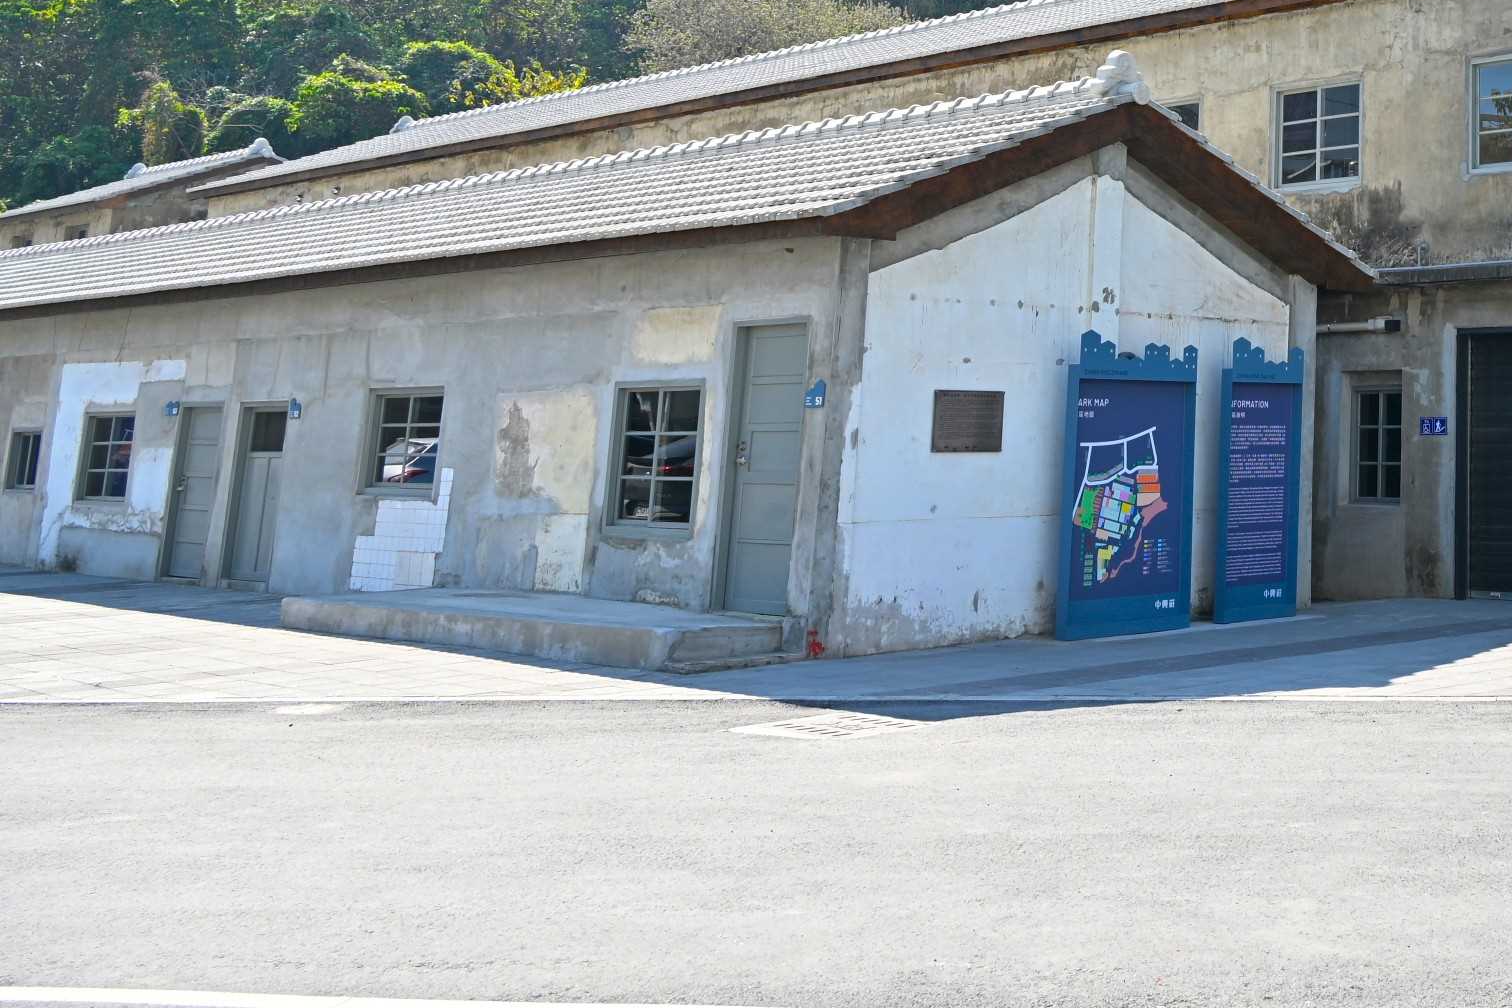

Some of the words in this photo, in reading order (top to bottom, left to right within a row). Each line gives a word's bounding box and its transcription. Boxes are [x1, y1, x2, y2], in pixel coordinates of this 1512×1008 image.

[1078, 398, 1092, 407] ARK
[1094, 398, 1110, 407] MAP
[1231, 399, 1269, 409] FORMATION
